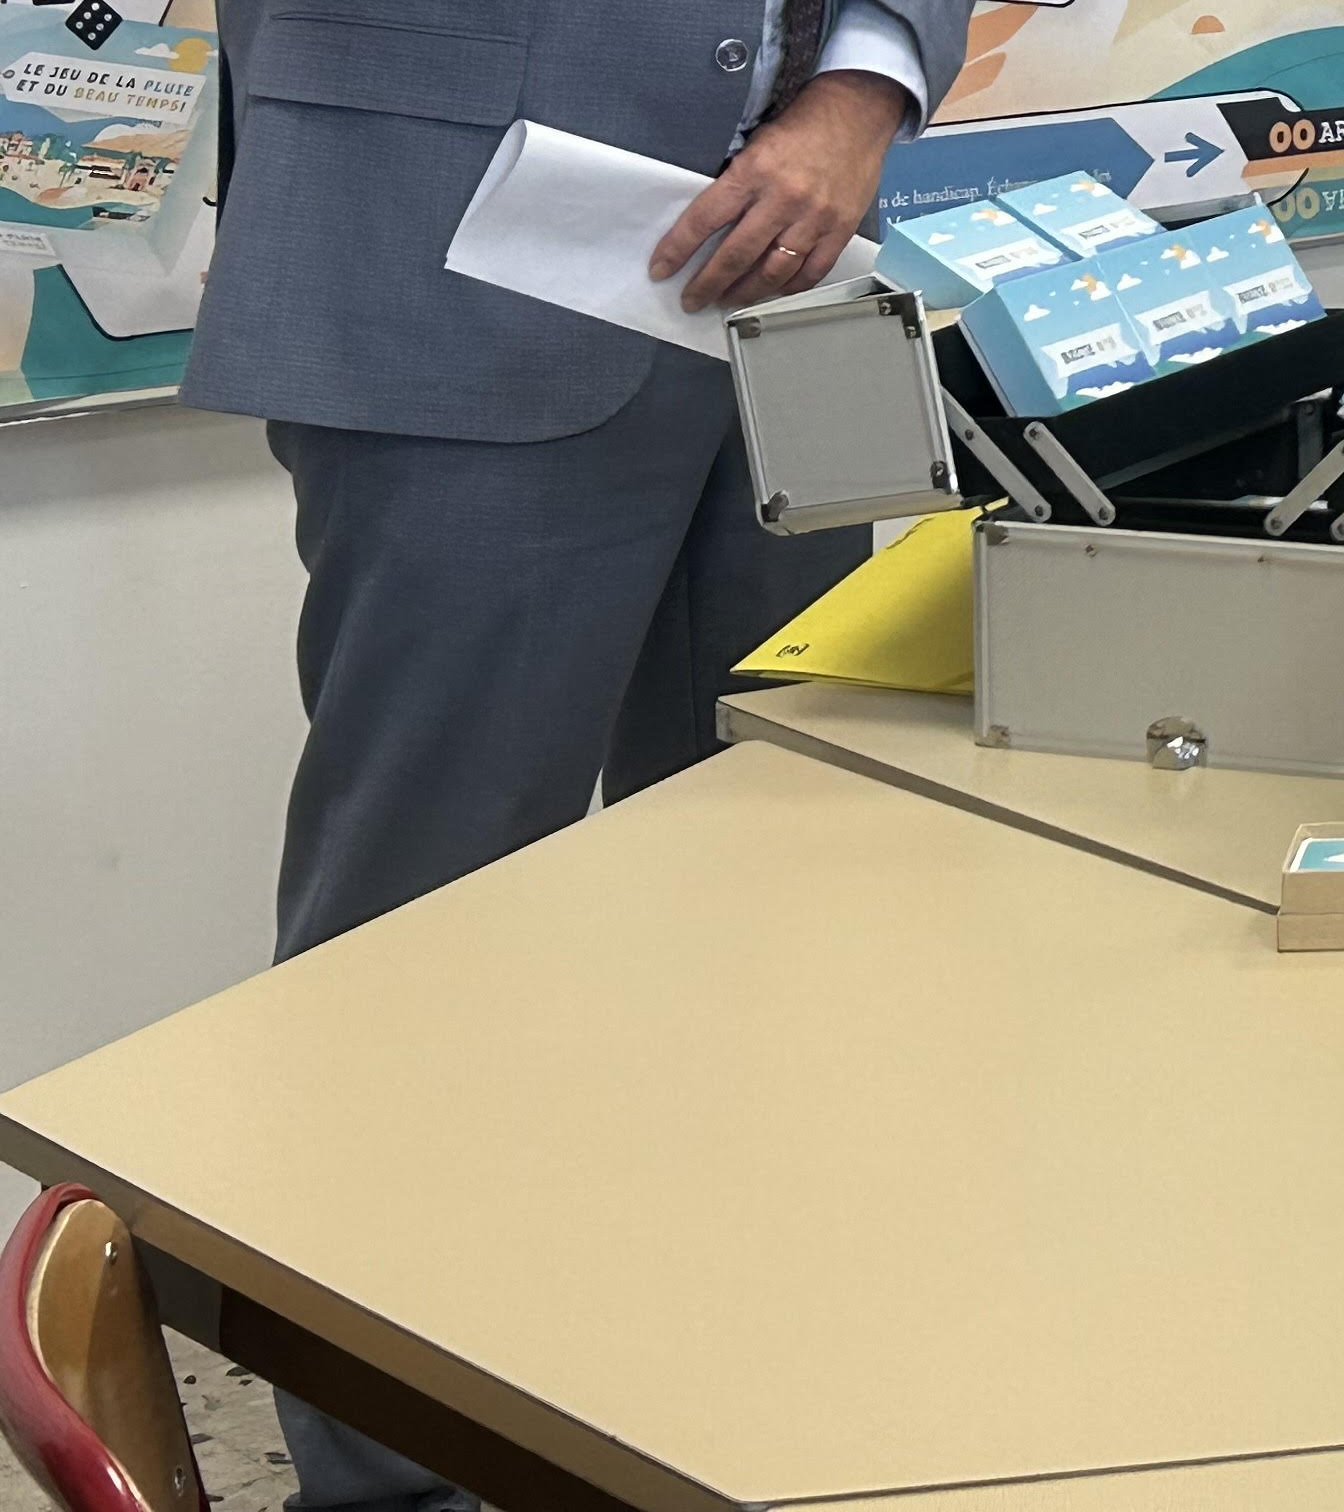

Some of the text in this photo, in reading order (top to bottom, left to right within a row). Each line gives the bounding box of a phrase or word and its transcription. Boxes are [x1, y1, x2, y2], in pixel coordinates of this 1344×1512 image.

[16, 79, 40, 92] ET
[44, 83, 69, 97] DU
[73, 87, 120, 103] BEAU
[23, 63, 195, 97] LE JEU DE LA PLUIE
[891, 191, 908, 208] de
